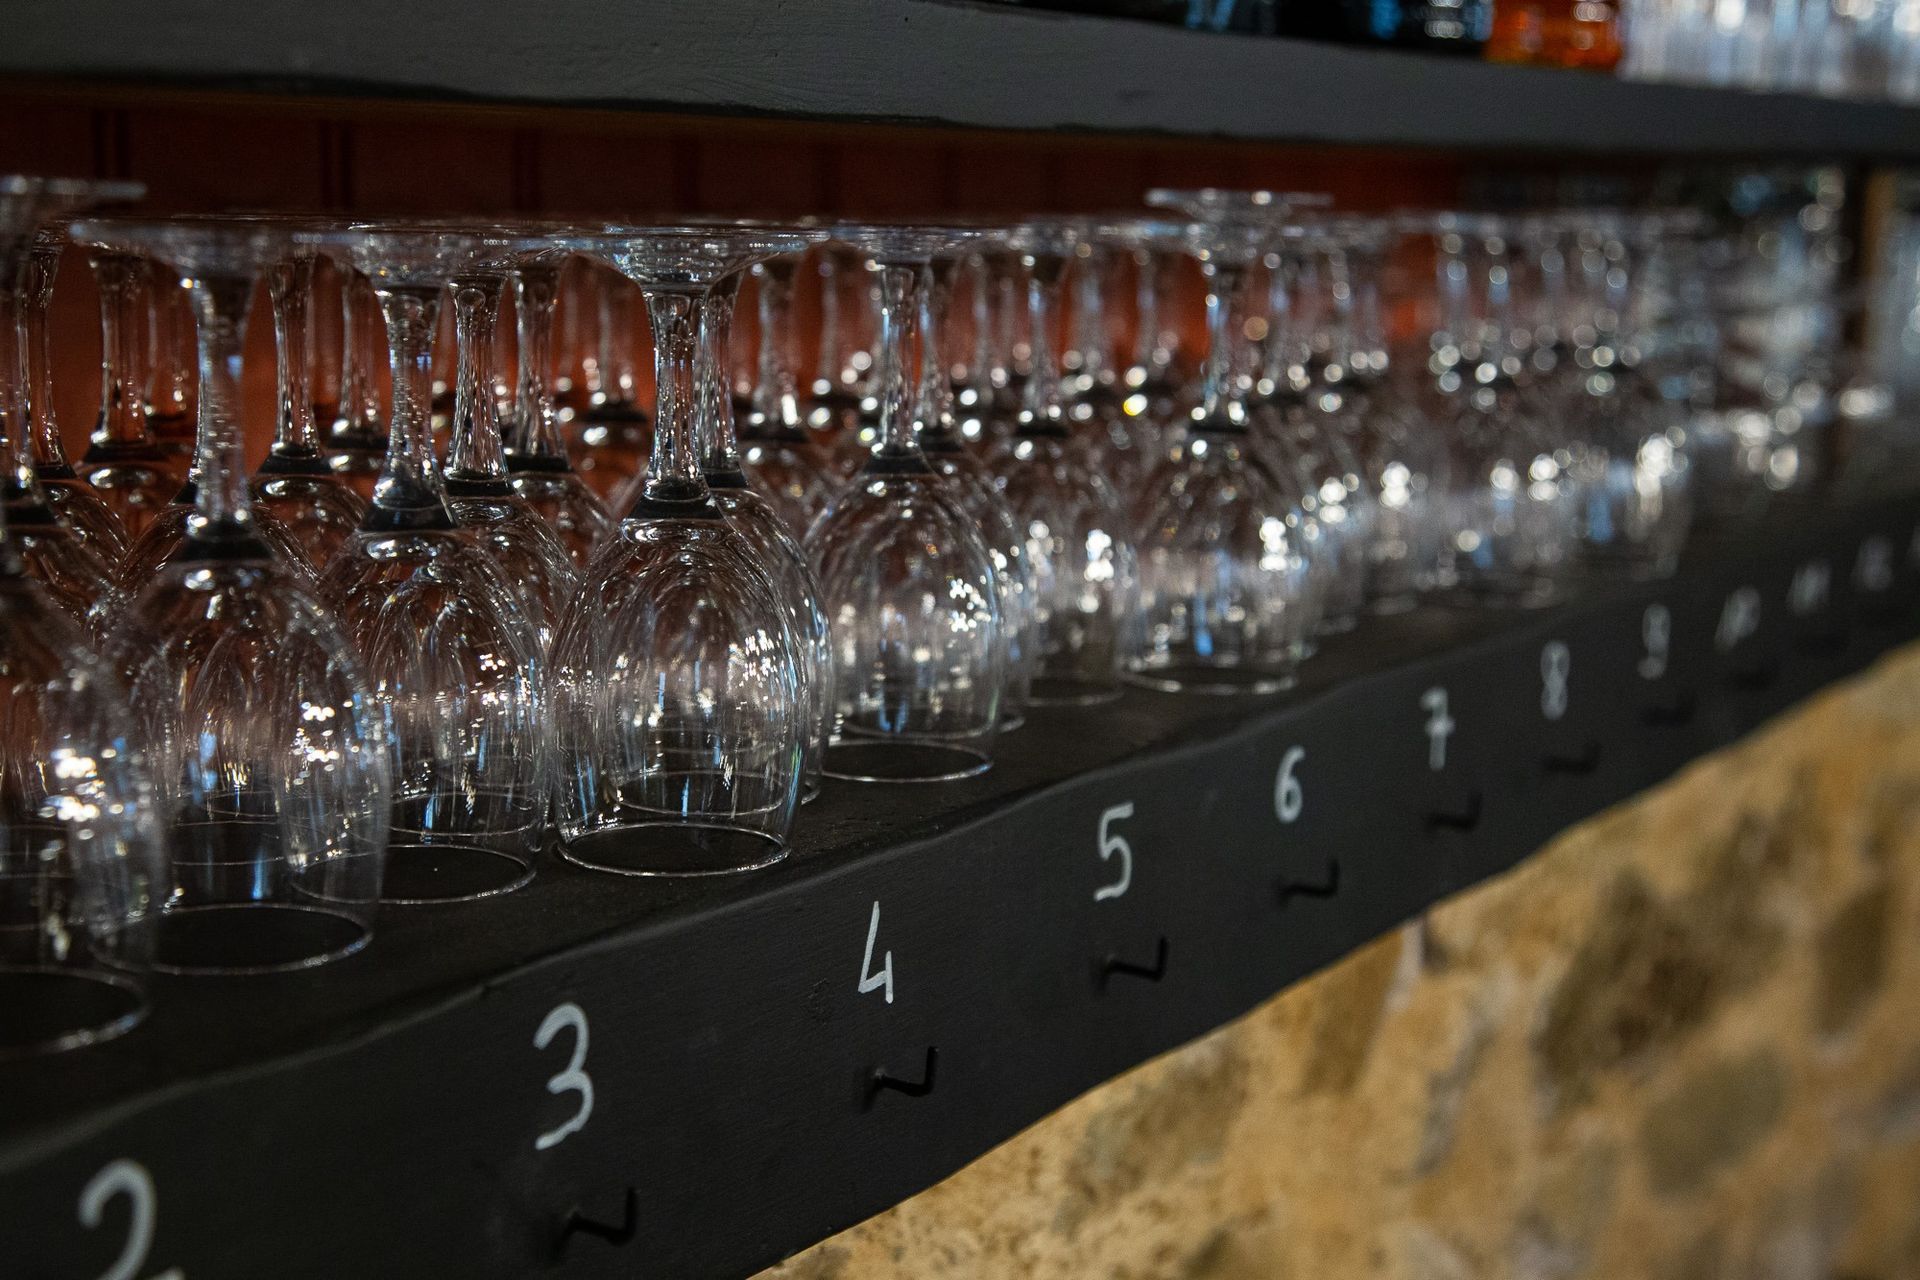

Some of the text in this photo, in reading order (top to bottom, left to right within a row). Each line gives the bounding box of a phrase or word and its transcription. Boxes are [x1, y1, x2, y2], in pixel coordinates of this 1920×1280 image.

[1420, 689, 1454, 769] 7
[1540, 641, 1570, 719] 8
[1274, 747, 1305, 822] 6
[1094, 802, 1134, 901] 5
[857, 900, 894, 1004] 4
[534, 1003, 594, 1150] 3
[79, 1159, 185, 1280] 2
